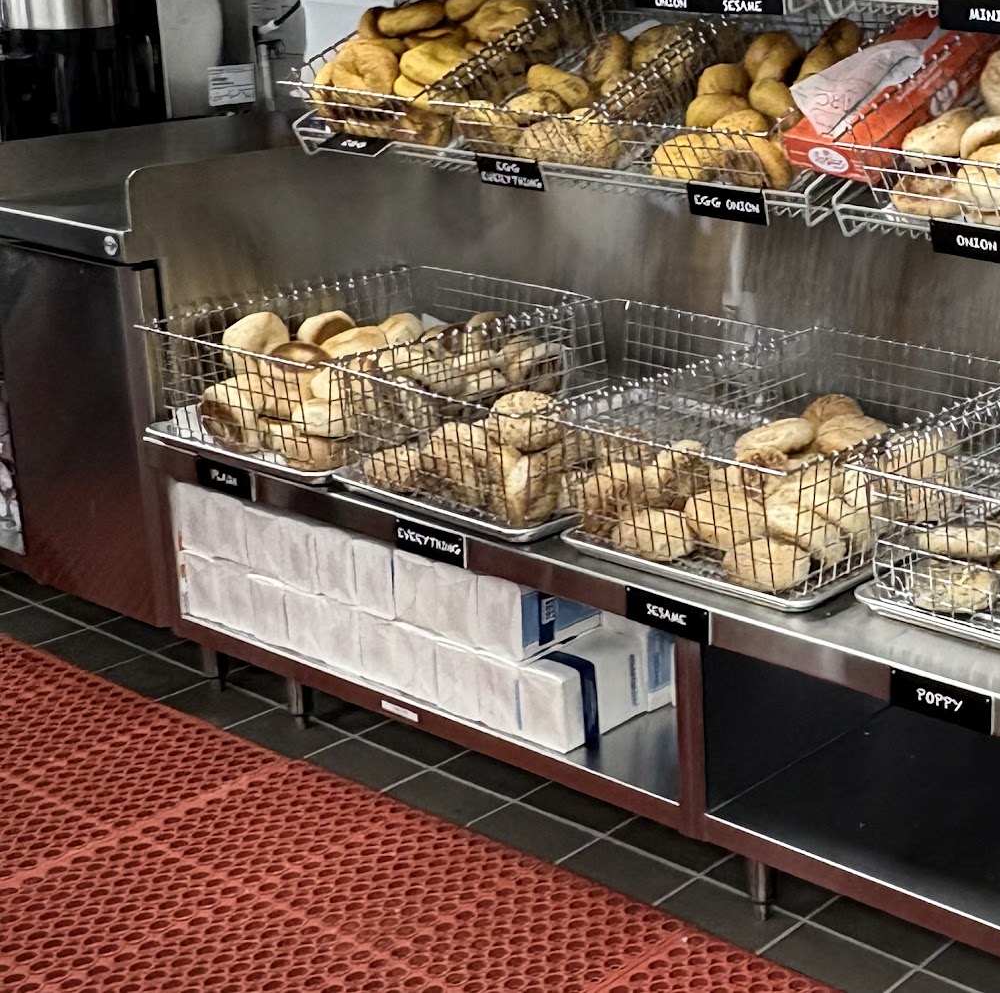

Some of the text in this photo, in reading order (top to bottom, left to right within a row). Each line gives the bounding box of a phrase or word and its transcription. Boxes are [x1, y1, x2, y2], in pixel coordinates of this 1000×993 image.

[722, 0, 763, 12] SESAME
[693, 194, 760, 214] EGG ONION
[956, 234, 998, 252] ONION
[397, 527, 462, 555] EVERYTHING
[645, 603, 687, 626] SESAME
[915, 687, 963, 712] POPPY
